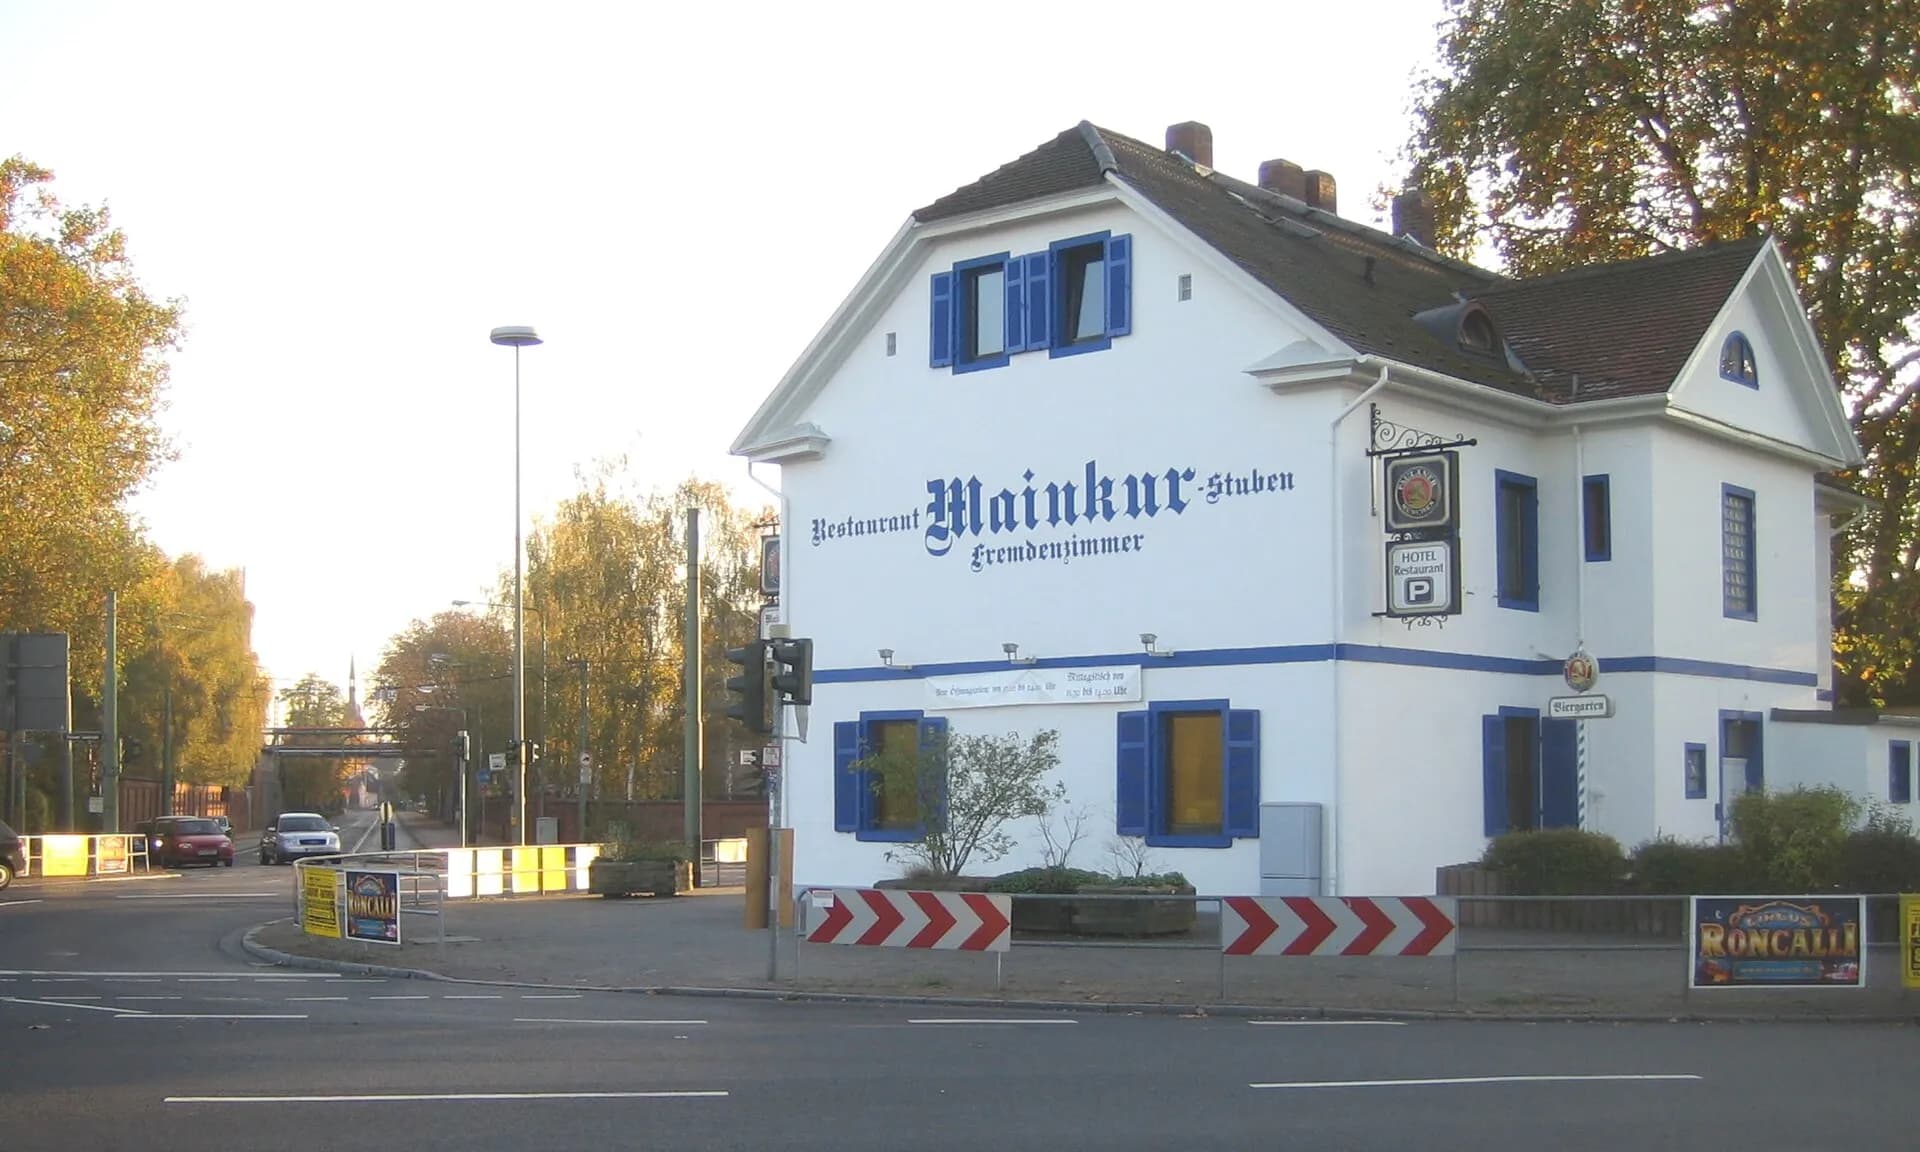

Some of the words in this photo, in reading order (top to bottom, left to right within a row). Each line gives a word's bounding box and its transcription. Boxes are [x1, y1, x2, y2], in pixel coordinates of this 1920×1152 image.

[811, 507, 920, 547] Restaurant
[970, 532, 1145, 573] Fremdenzimmer
[1402, 551, 1437, 563] HOTEL
[1394, 564, 1444, 576] Restaurant
[1409, 581, 1430, 601] P
[1553, 701, 1605, 714] Biergarten
[1700, 922, 1857, 958] RONCALLI
